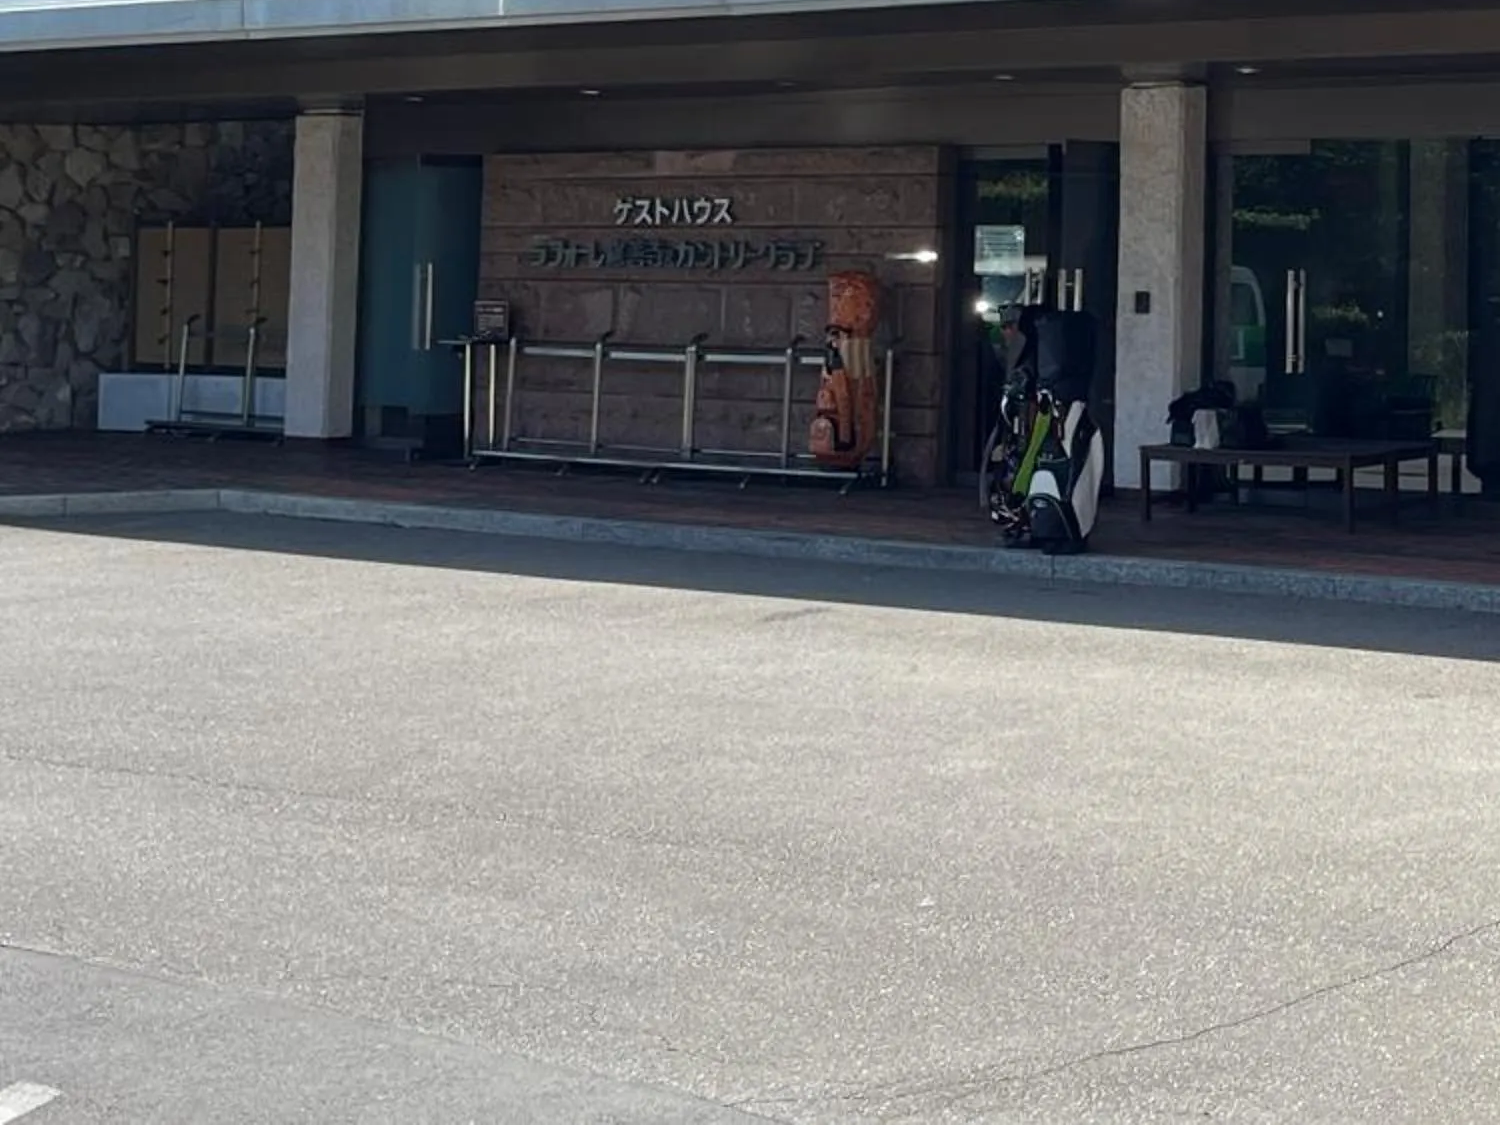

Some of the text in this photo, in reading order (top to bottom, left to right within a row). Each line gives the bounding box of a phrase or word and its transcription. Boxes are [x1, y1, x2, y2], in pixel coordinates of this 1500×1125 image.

[613, 198, 733, 225] ゲストハウス
[529, 239, 823, 271] ラフォーレカントリークラブ
